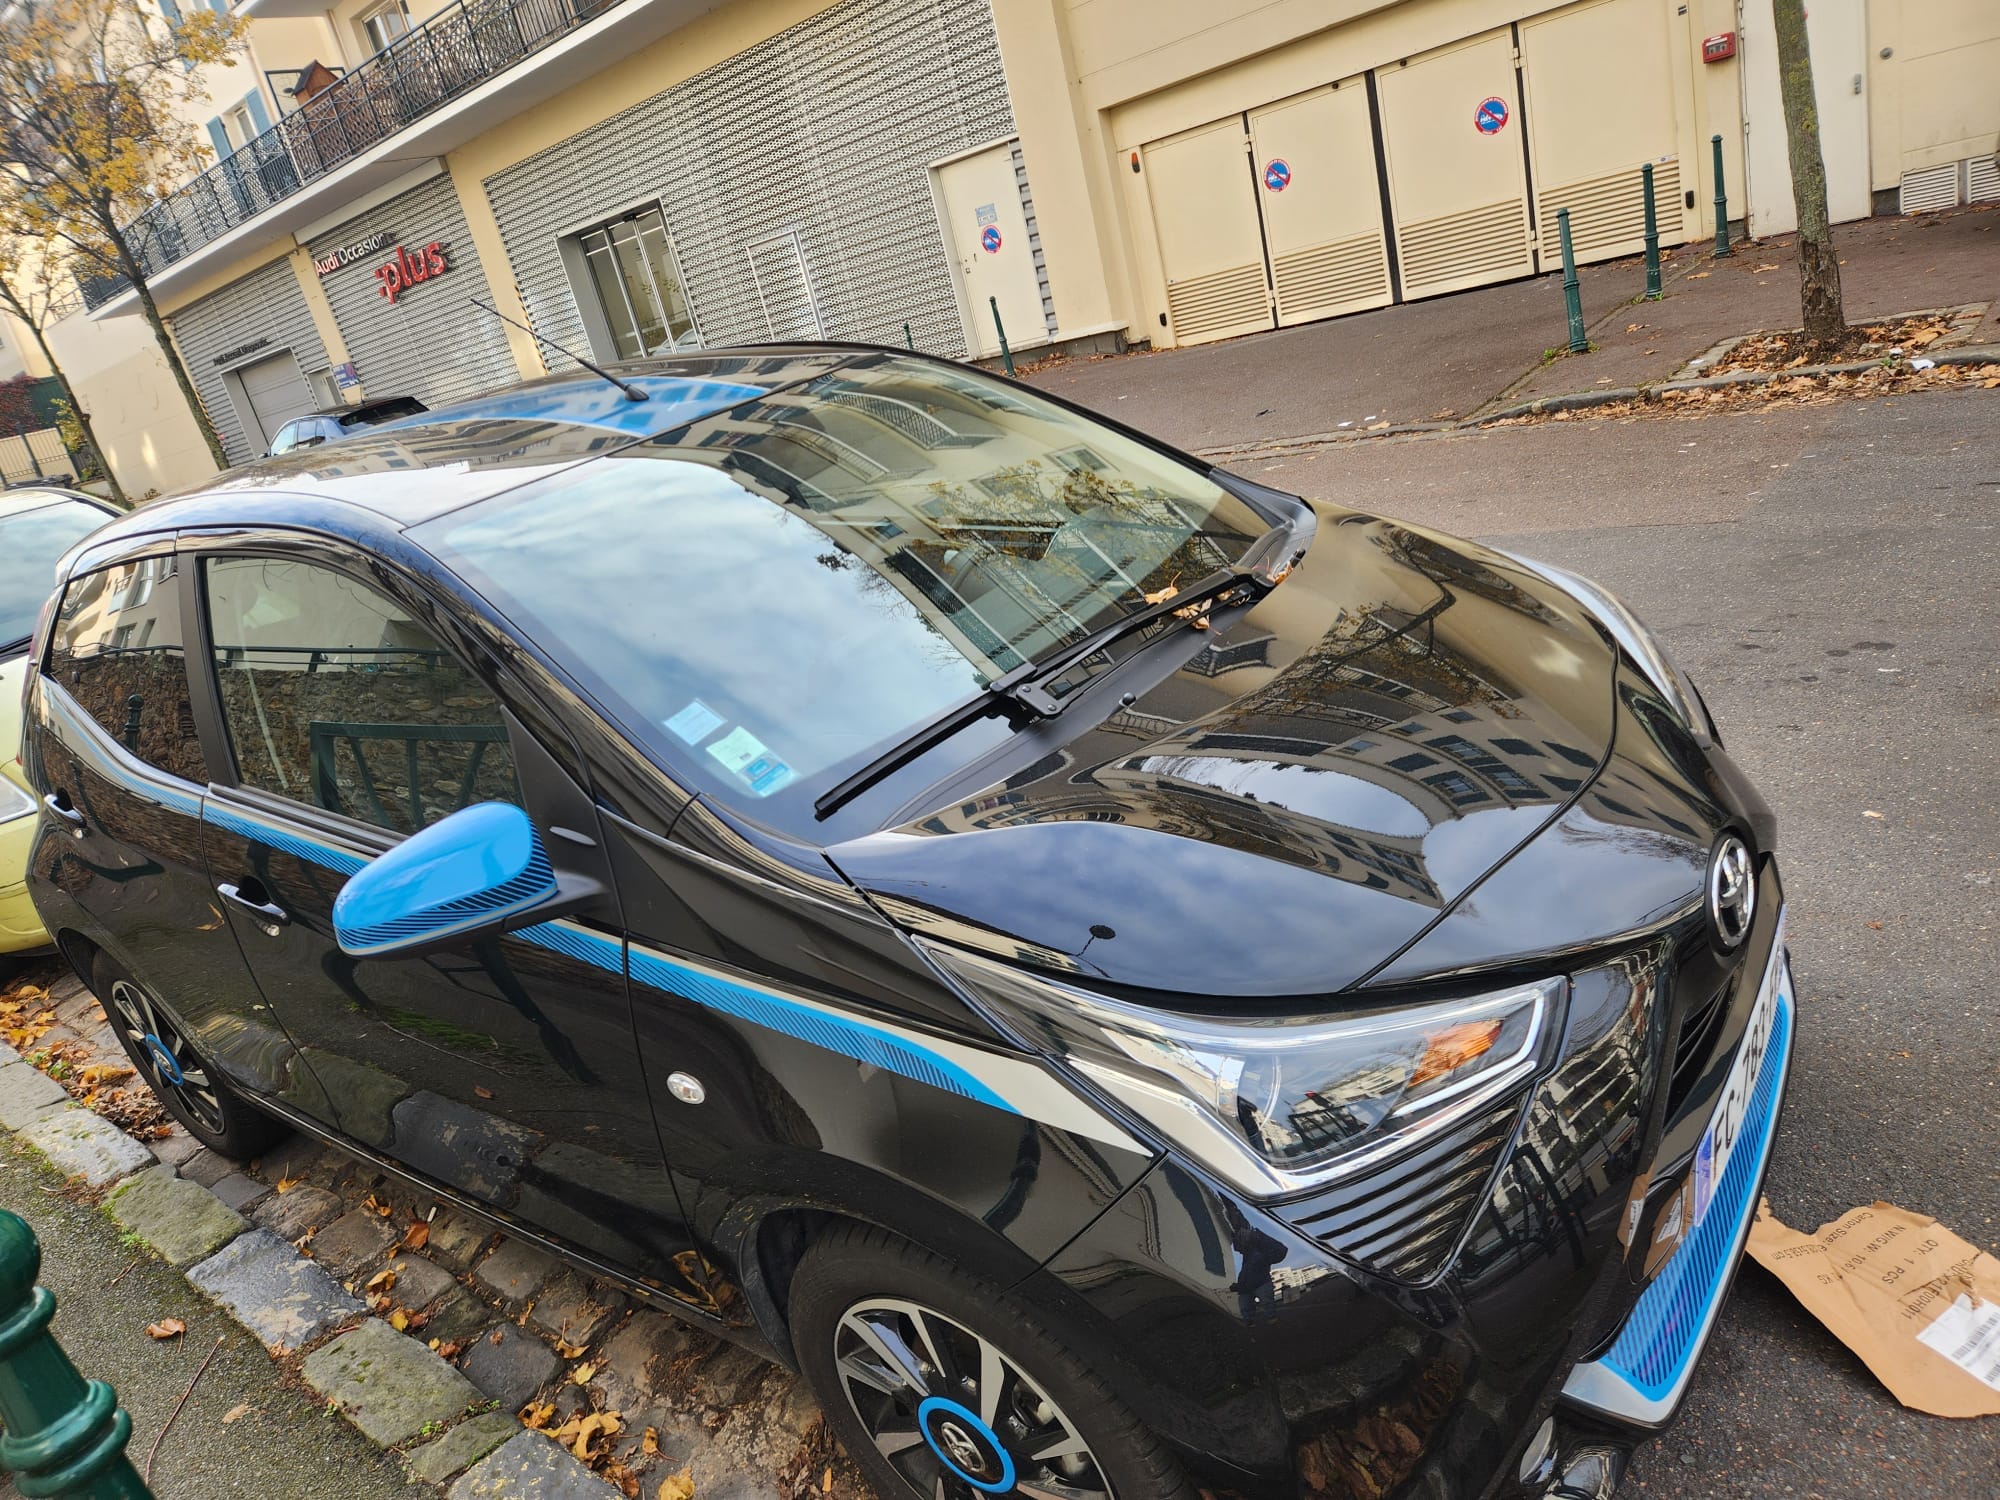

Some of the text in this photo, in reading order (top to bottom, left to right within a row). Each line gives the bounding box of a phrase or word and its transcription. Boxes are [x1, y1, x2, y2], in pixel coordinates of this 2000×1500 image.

[314, 252, 339, 277] Audi
[1843, 1212, 1874, 1230] Carton
[1913, 1239, 1939, 1257] QTY:
[1882, 1265, 1906, 1285] PCS
